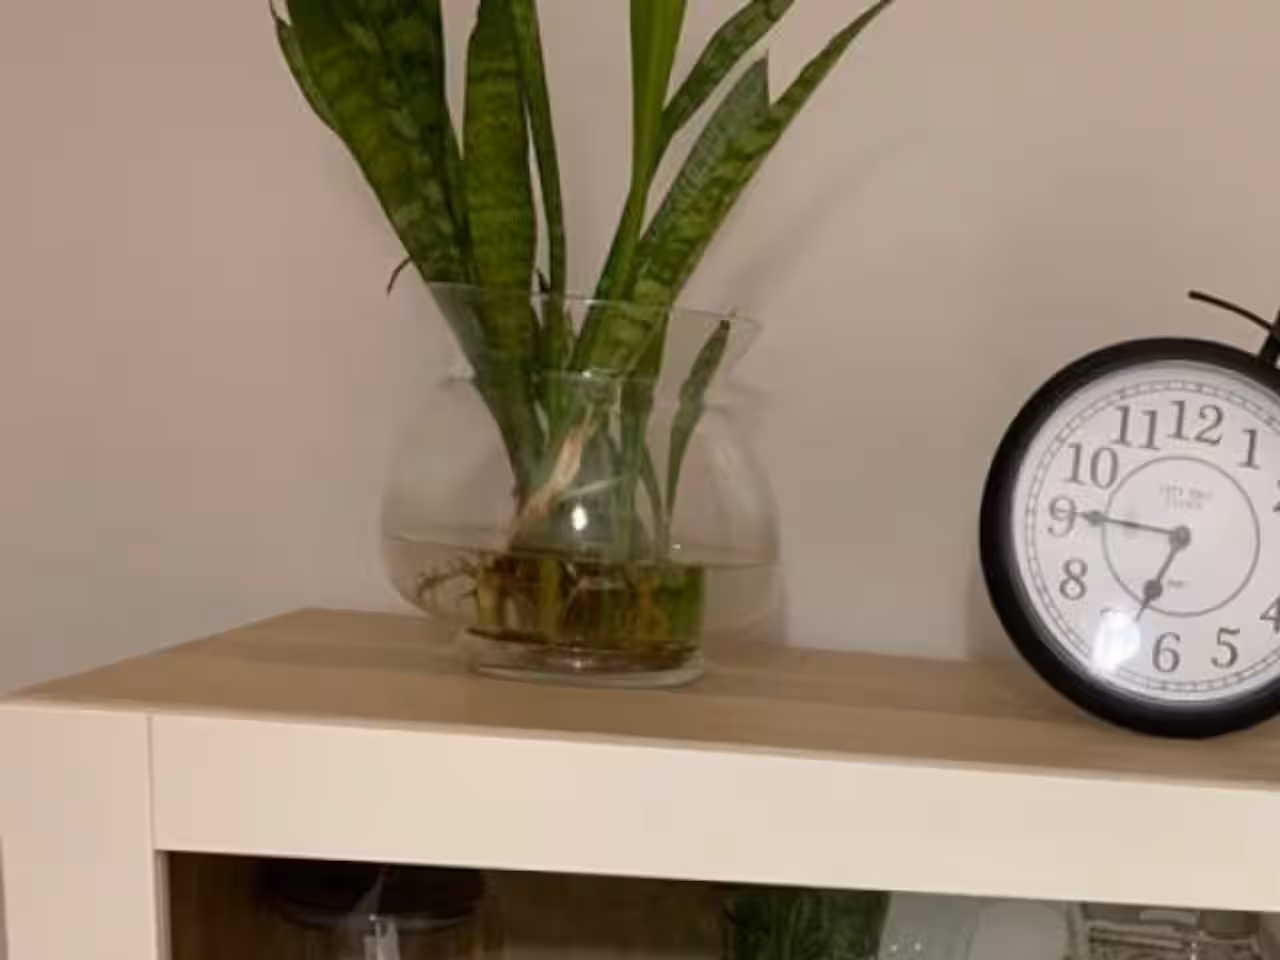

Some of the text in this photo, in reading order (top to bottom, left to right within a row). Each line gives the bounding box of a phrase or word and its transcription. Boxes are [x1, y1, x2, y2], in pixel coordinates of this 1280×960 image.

[1112, 405, 1160, 451] 11
[1168, 400, 1225, 447] 12
[1064, 443, 1119, 489] 10
[1238, 428, 1261, 469] 1
[1047, 496, 1077, 538] 9
[1058, 558, 1089, 600] 8
[1152, 632, 1181, 673] 6
[1211, 627, 1241, 668] 5
